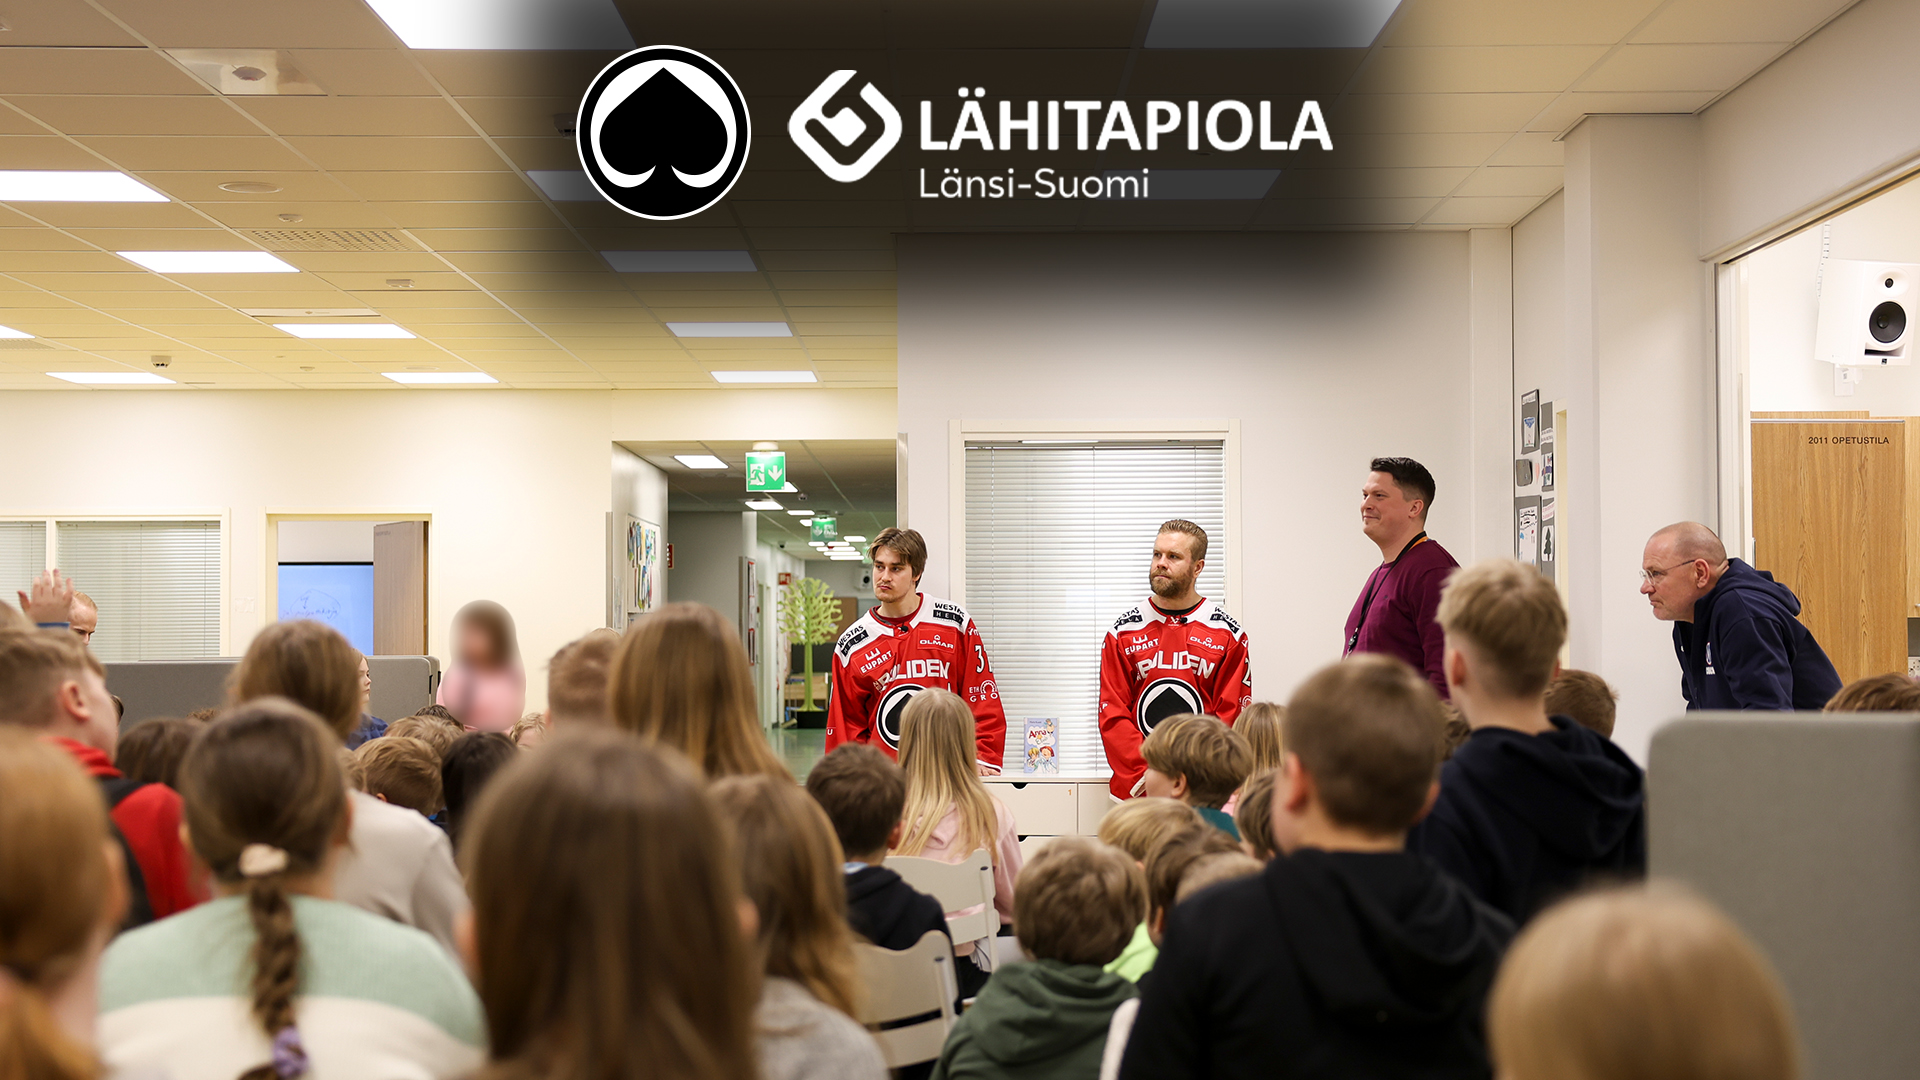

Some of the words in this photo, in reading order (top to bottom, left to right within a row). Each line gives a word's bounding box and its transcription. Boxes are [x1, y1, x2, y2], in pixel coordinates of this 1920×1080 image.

[1808, 436, 1828, 445] 2011
[1831, 436, 1890, 445] OPETUSTILA
[837, 624, 864, 648] WESTAS
[1189, 636, 1225, 651] OLMAR
[919, 639, 955, 650] OLMAR
[1124, 637, 1160, 656] EUPART
[860, 650, 893, 674] EUPART
[1028, 730, 1047, 739] Anna
